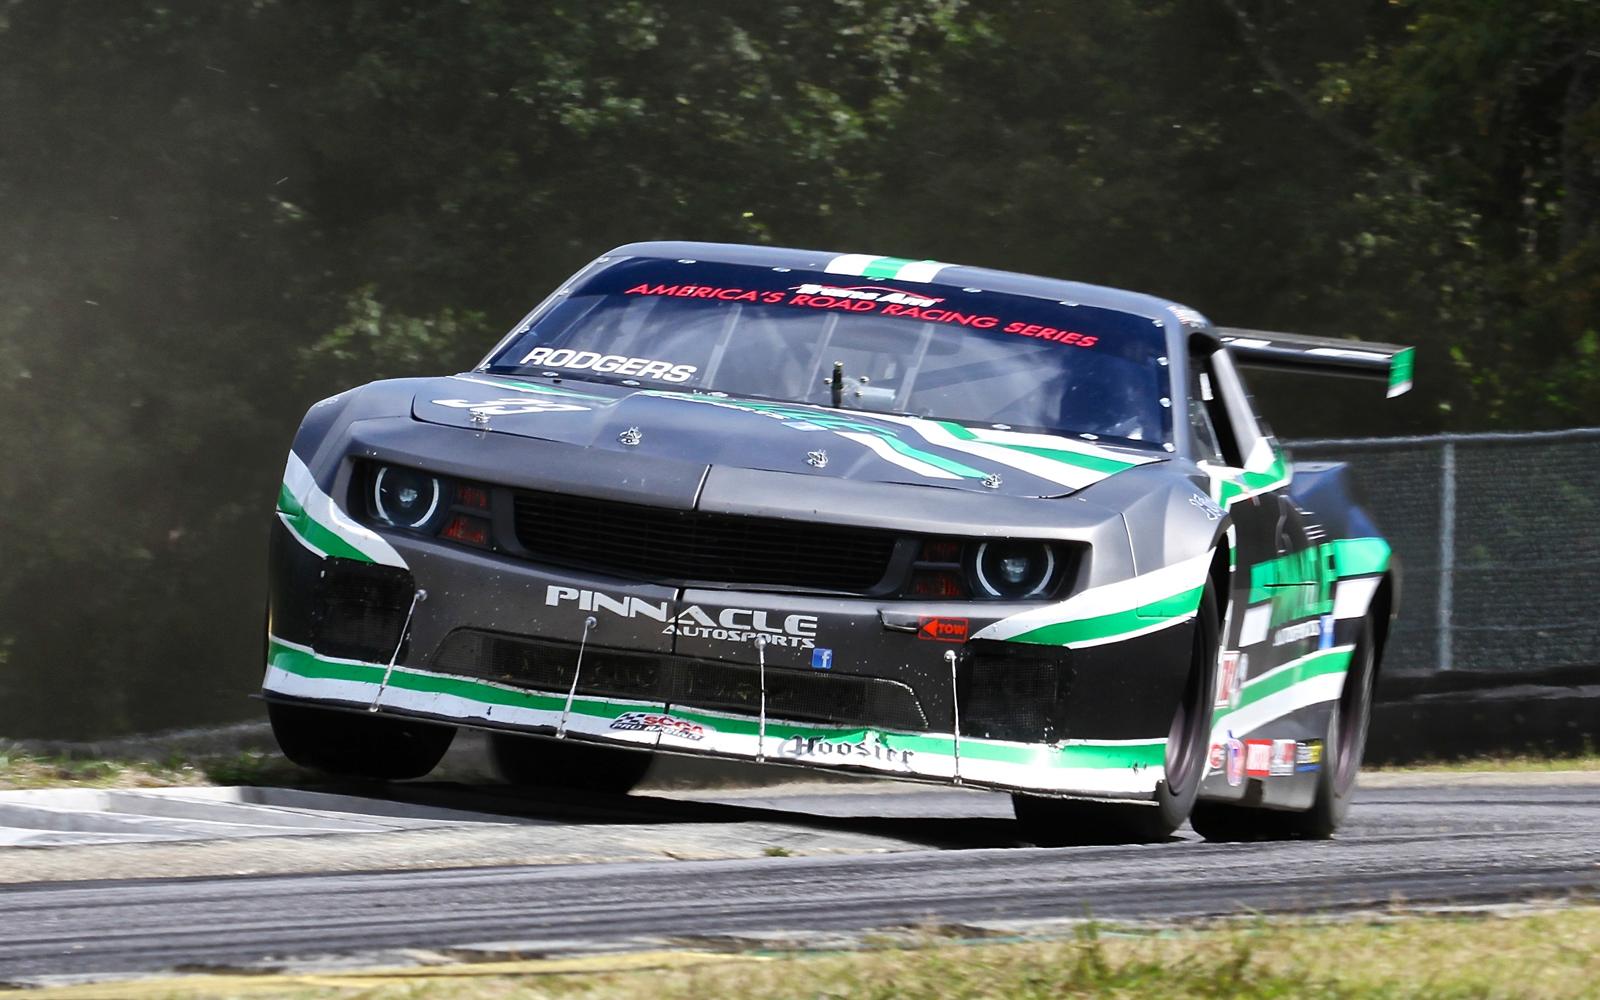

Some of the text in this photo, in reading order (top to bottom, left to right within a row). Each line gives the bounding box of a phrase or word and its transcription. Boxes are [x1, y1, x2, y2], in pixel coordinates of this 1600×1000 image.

[625, 283, 1099, 347] AMERICA'S ROAD RACING SERIES
[519, 347, 698, 382] RODGERS
[545, 585, 819, 637] PINNACLE
[662, 624, 816, 649] AUTOSPORTS
[938, 624, 966, 635] TOW
[778, 735, 915, 765] Hoosier
